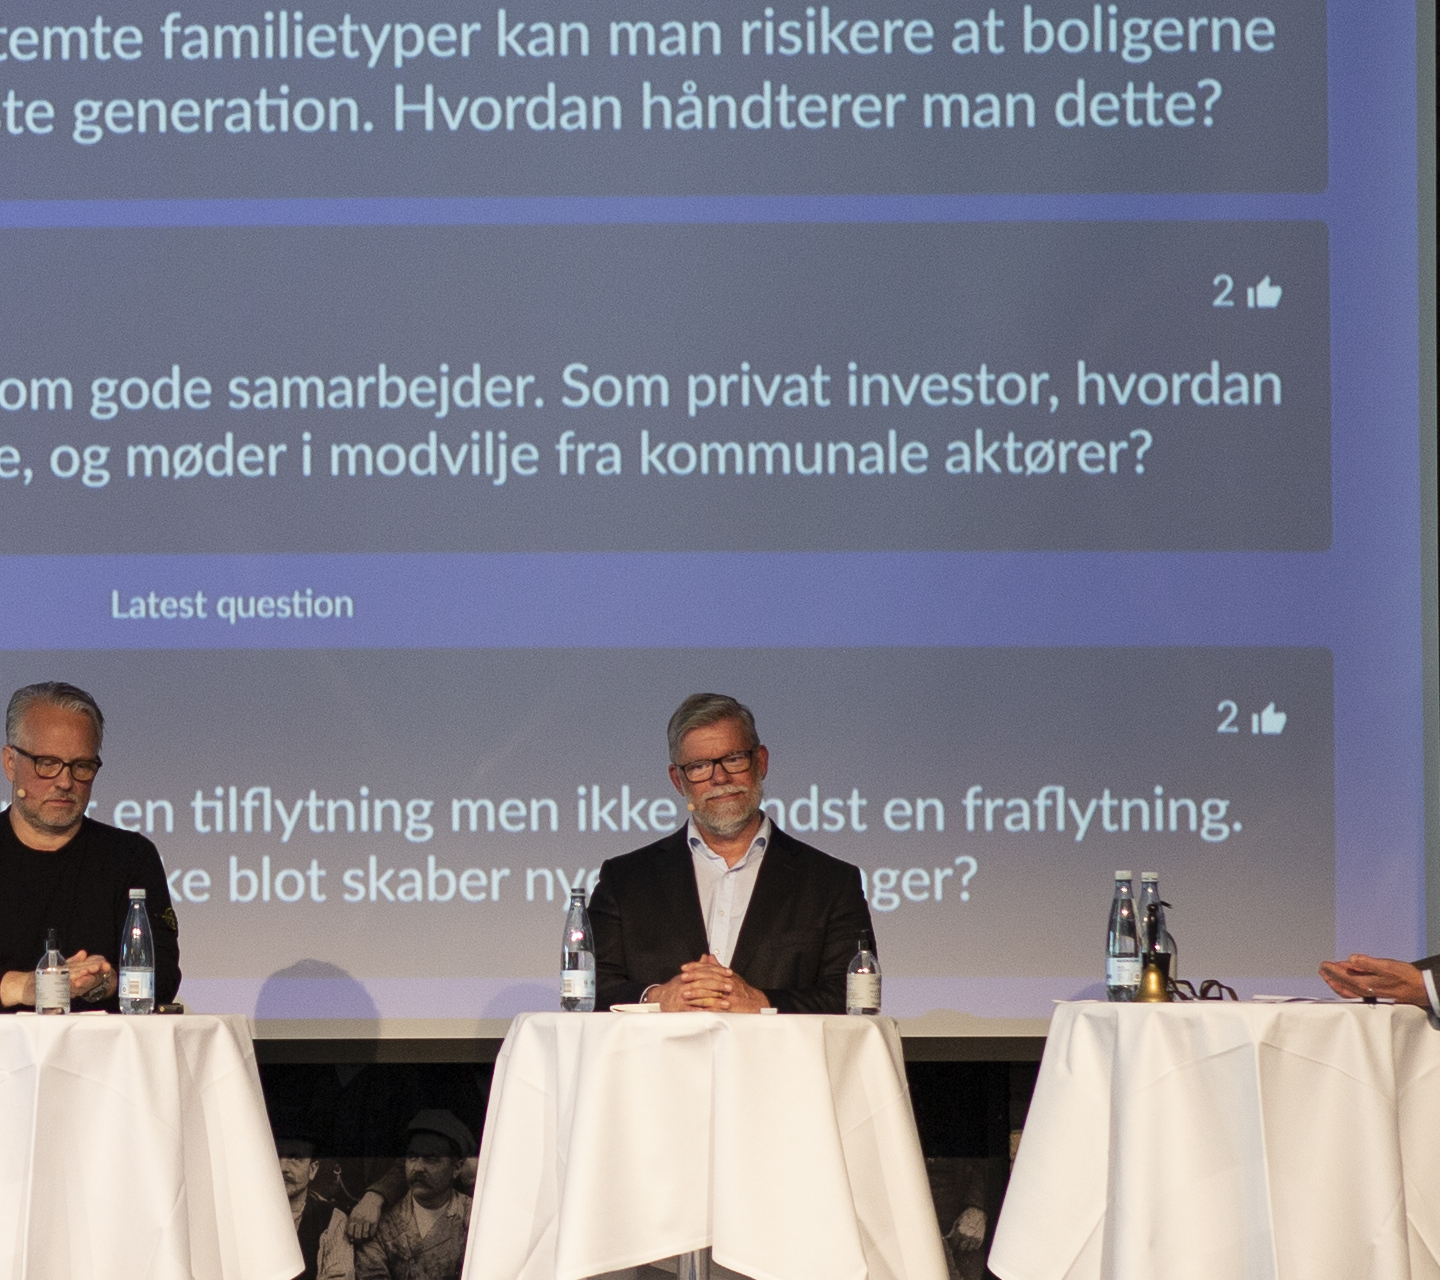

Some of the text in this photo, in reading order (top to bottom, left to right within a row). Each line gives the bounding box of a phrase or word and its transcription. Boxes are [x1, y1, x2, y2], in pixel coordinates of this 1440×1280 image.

[159, 9, 482, 69] familietyper
[497, 7, 590, 58] kan
[609, 20, 722, 57] man
[741, 5, 935, 57] risikere
[951, 8, 1006, 55] at
[1022, 3, 1276, 64] boligerne
[71, 83, 374, 146] generation.
[394, 81, 623, 132] Hvordan
[642, 79, 907, 131] håndterer
[922, 92, 1036, 129] man
[1054, 77, 1223, 128] dette?
[1212, 273, 1235, 308] 2
[89, 363, 213, 421] gode
[228, 362, 545, 419] samarbejder.
[561, 361, 670, 409] Som
[687, 360, 832, 418] privat
[847, 360, 1060, 414] investor,
[1076, 359, 1282, 407] hvordan
[49, 444, 111, 489] og
[126, 431, 288, 480] møder
[301, 430, 312, 477] i
[330, 429, 540, 487] modvilje
[554, 429, 622, 476] fra
[640, 428, 930, 476] kommunale
[944, 427, 1154, 477] aktører?
[111, 587, 354, 625] Latest question
[1216, 699, 1239, 734] 2
[113, 799, 174, 834] en
[190, 785, 436, 845] tilflytning
[451, 798, 559, 833] men
[577, 784, 678, 832] ikke
[758, 783, 868, 832] ndst
[882, 797, 945, 832] en
[961, 784, 1243, 843] fraflytning.
[229, 855, 327, 903] blot
[342, 855, 511, 902] skaber
